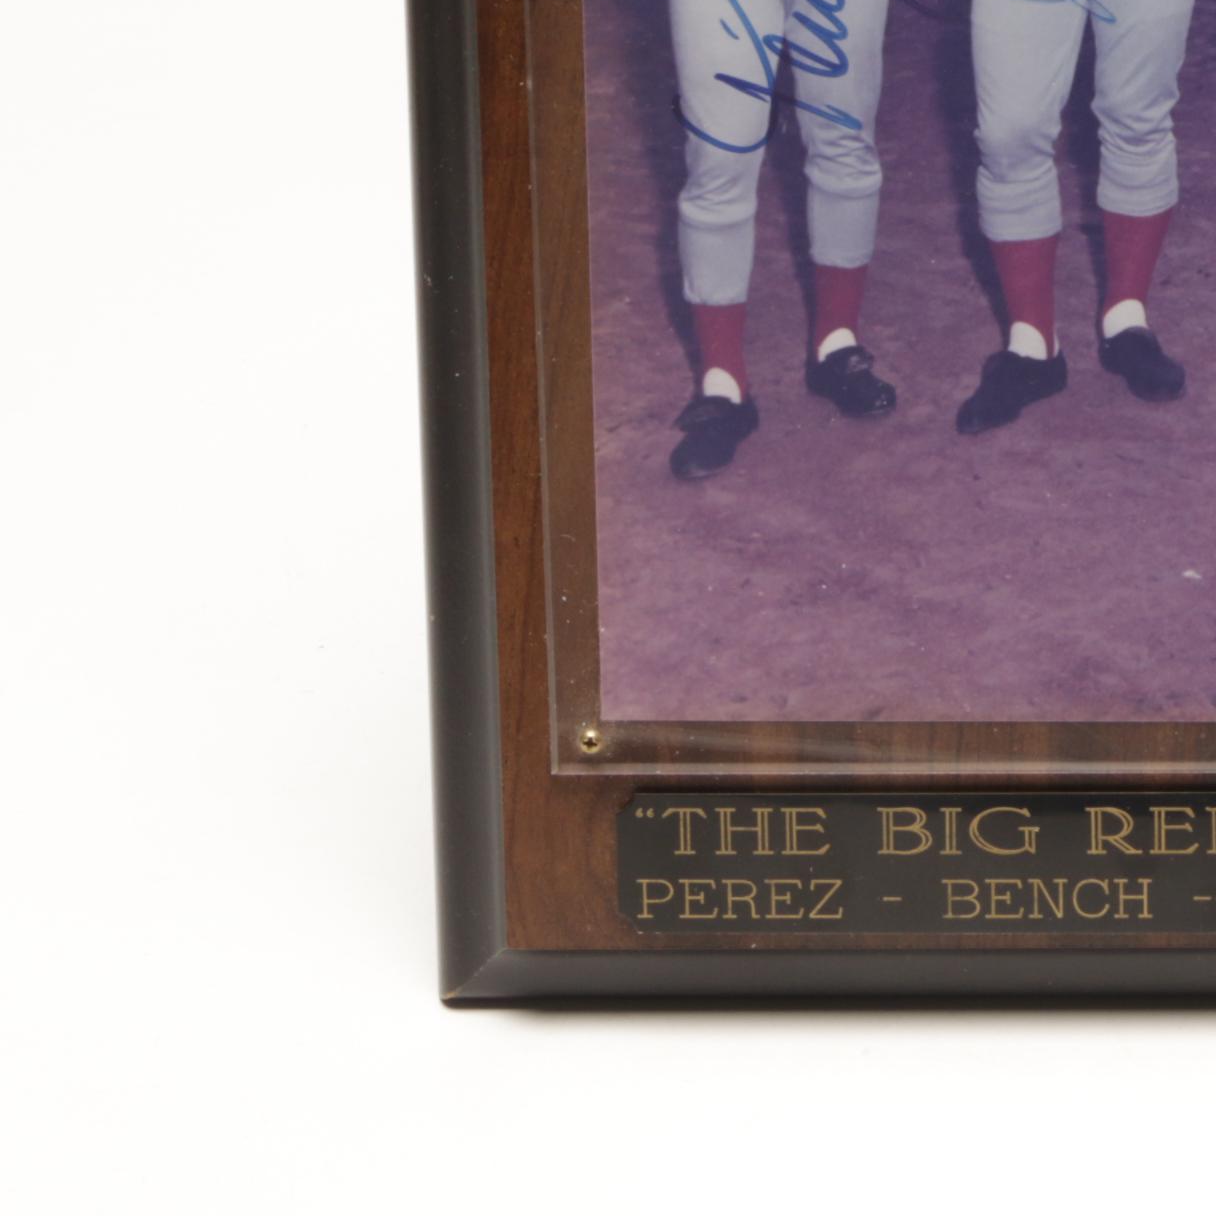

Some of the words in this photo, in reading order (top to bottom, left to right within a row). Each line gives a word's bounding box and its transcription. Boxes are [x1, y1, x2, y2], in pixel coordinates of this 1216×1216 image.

[876, 806, 1041, 856] BIG
[636, 878, 844, 919] PEREZ
[942, 878, 1154, 919] BENCH
